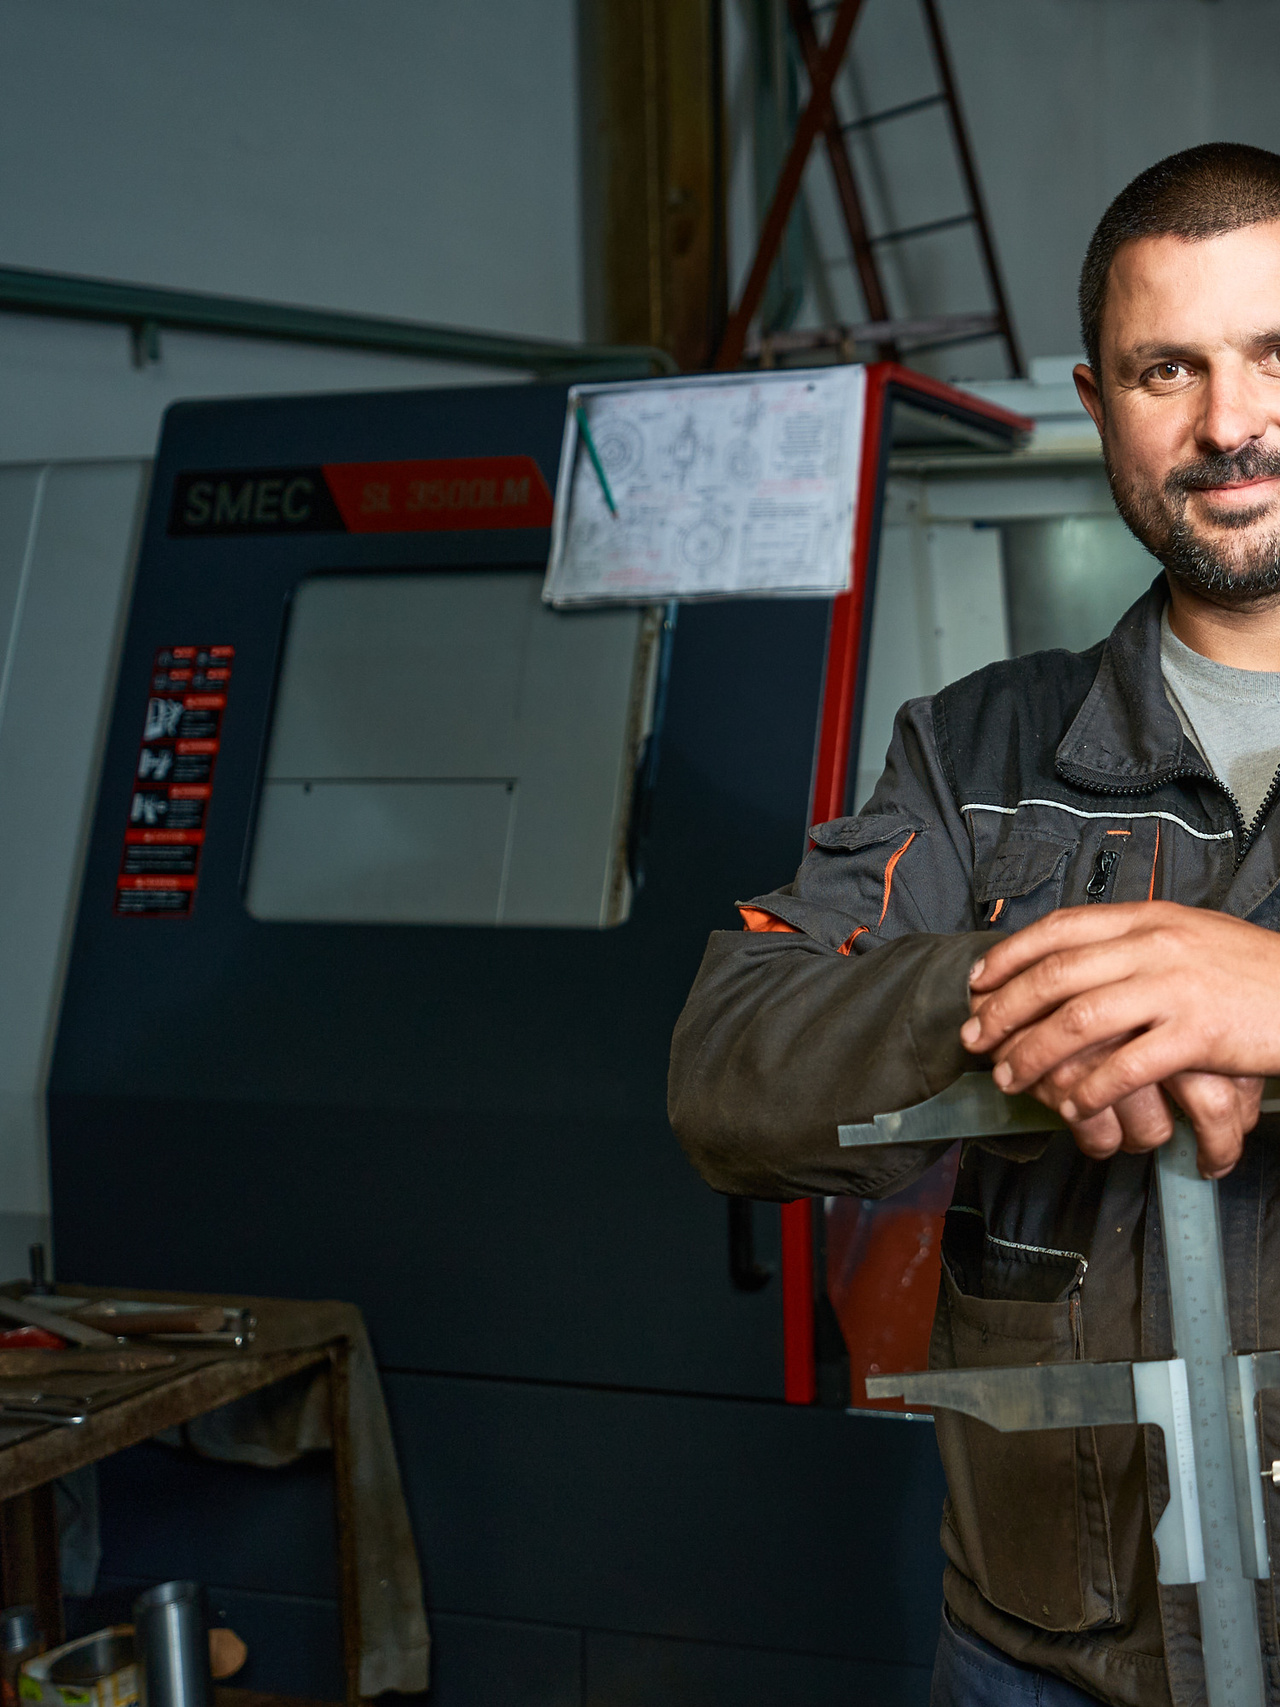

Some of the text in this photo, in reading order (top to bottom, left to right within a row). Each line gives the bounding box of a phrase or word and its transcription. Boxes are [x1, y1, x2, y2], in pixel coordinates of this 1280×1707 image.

[184, 476, 315, 526] SMEC
[359, 476, 531, 514] SL 3500LM
